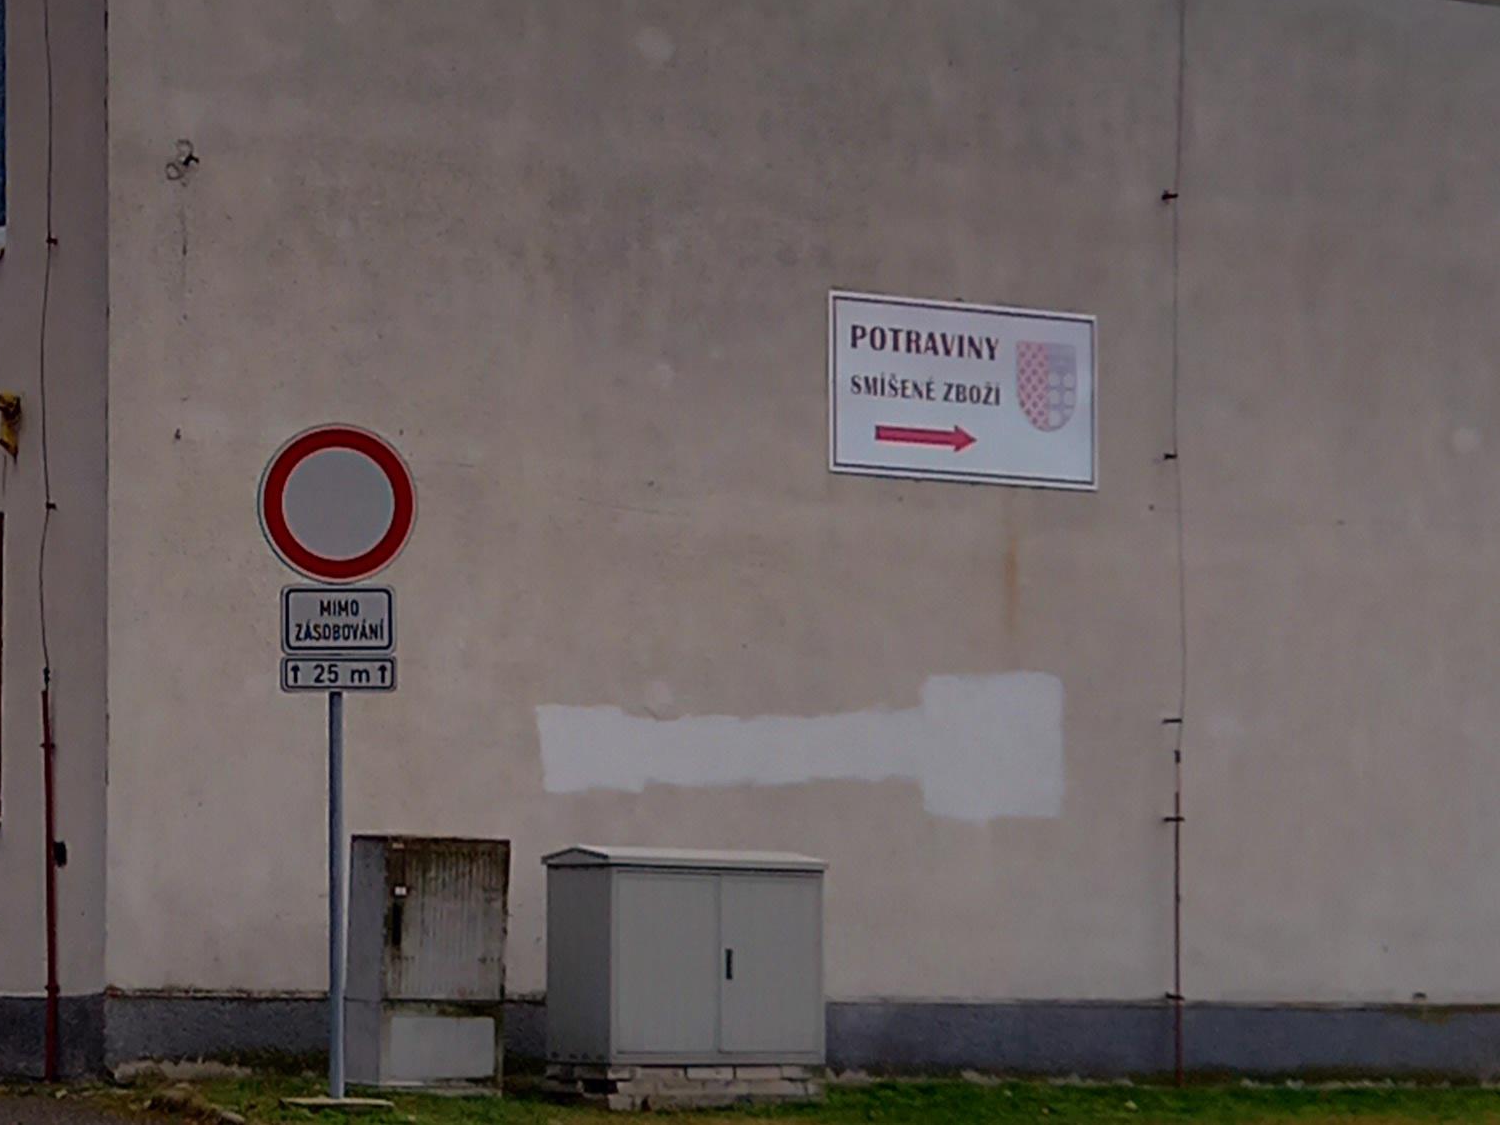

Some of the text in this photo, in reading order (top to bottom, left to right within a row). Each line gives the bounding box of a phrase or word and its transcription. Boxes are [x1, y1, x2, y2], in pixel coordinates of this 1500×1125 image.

[850, 324, 999, 361] POTRAVINY
[850, 372, 1001, 406] SMÍŠENÉ ZBOŽÍ
[319, 599, 360, 617] MIMO
[294, 618, 384, 641] ZÁSOBOVÁNÍ
[313, 663, 371, 684] 25 m
